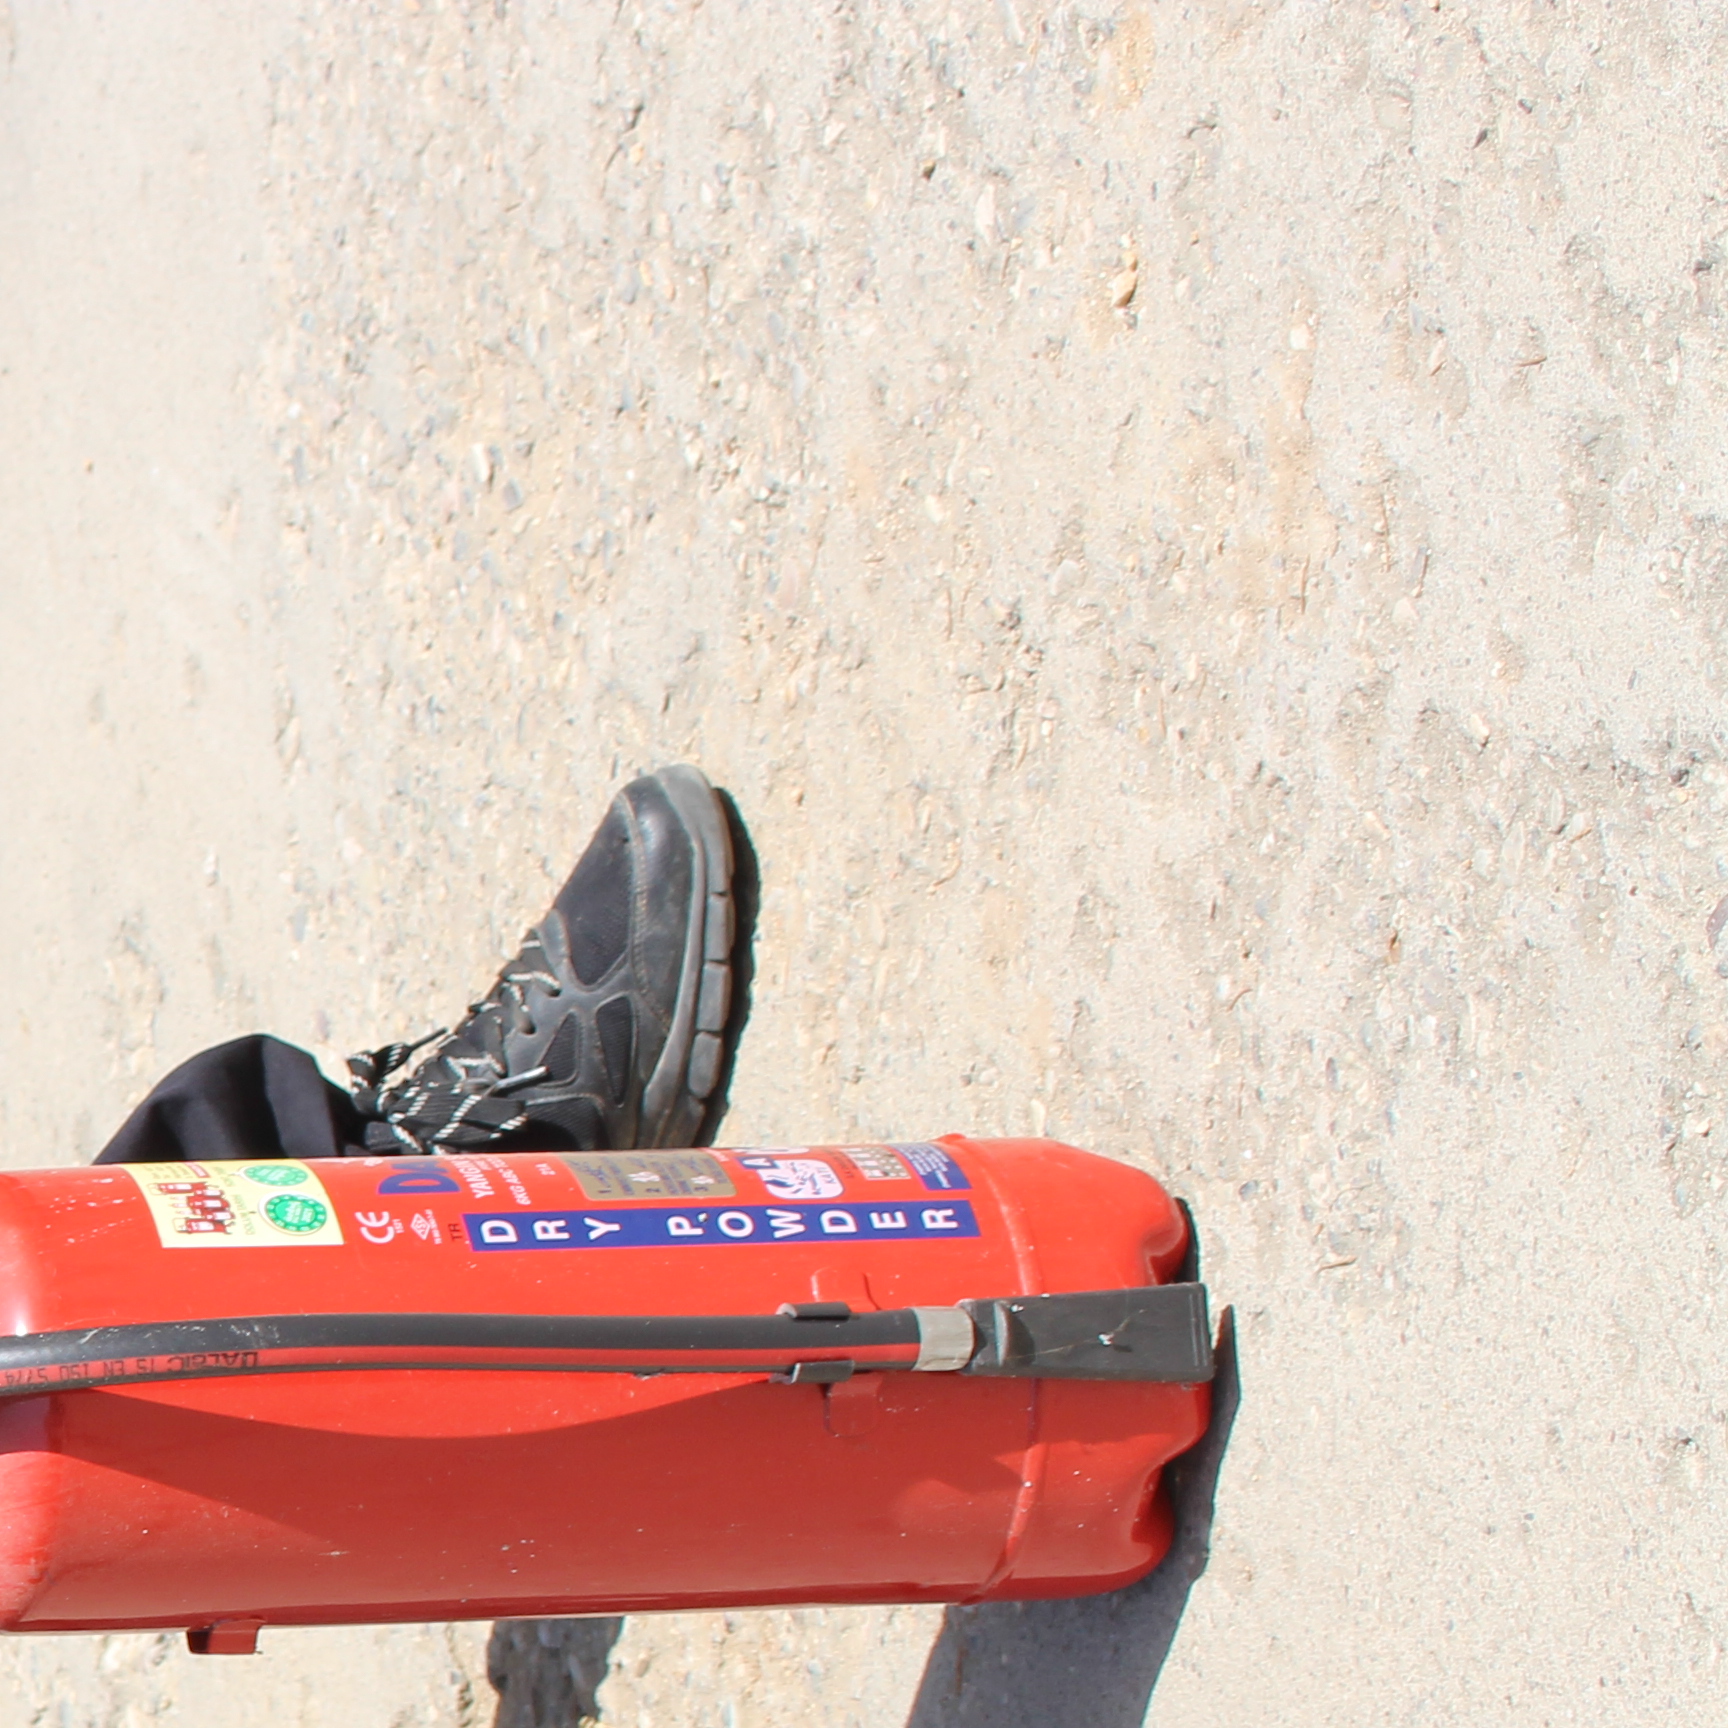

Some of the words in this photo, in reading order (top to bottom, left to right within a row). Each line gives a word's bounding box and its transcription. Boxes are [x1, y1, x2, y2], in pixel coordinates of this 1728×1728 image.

[451, 1160, 495, 1199] YANGIN
[498, 1168, 522, 1184] ABC
[509, 1185, 532, 1205] 6KG
[354, 1211, 395, 1244] CE
[448, 1222, 463, 1241] TR
[480, 1217, 622, 1243] DRY
[666, 1208, 960, 1238] POWDER
